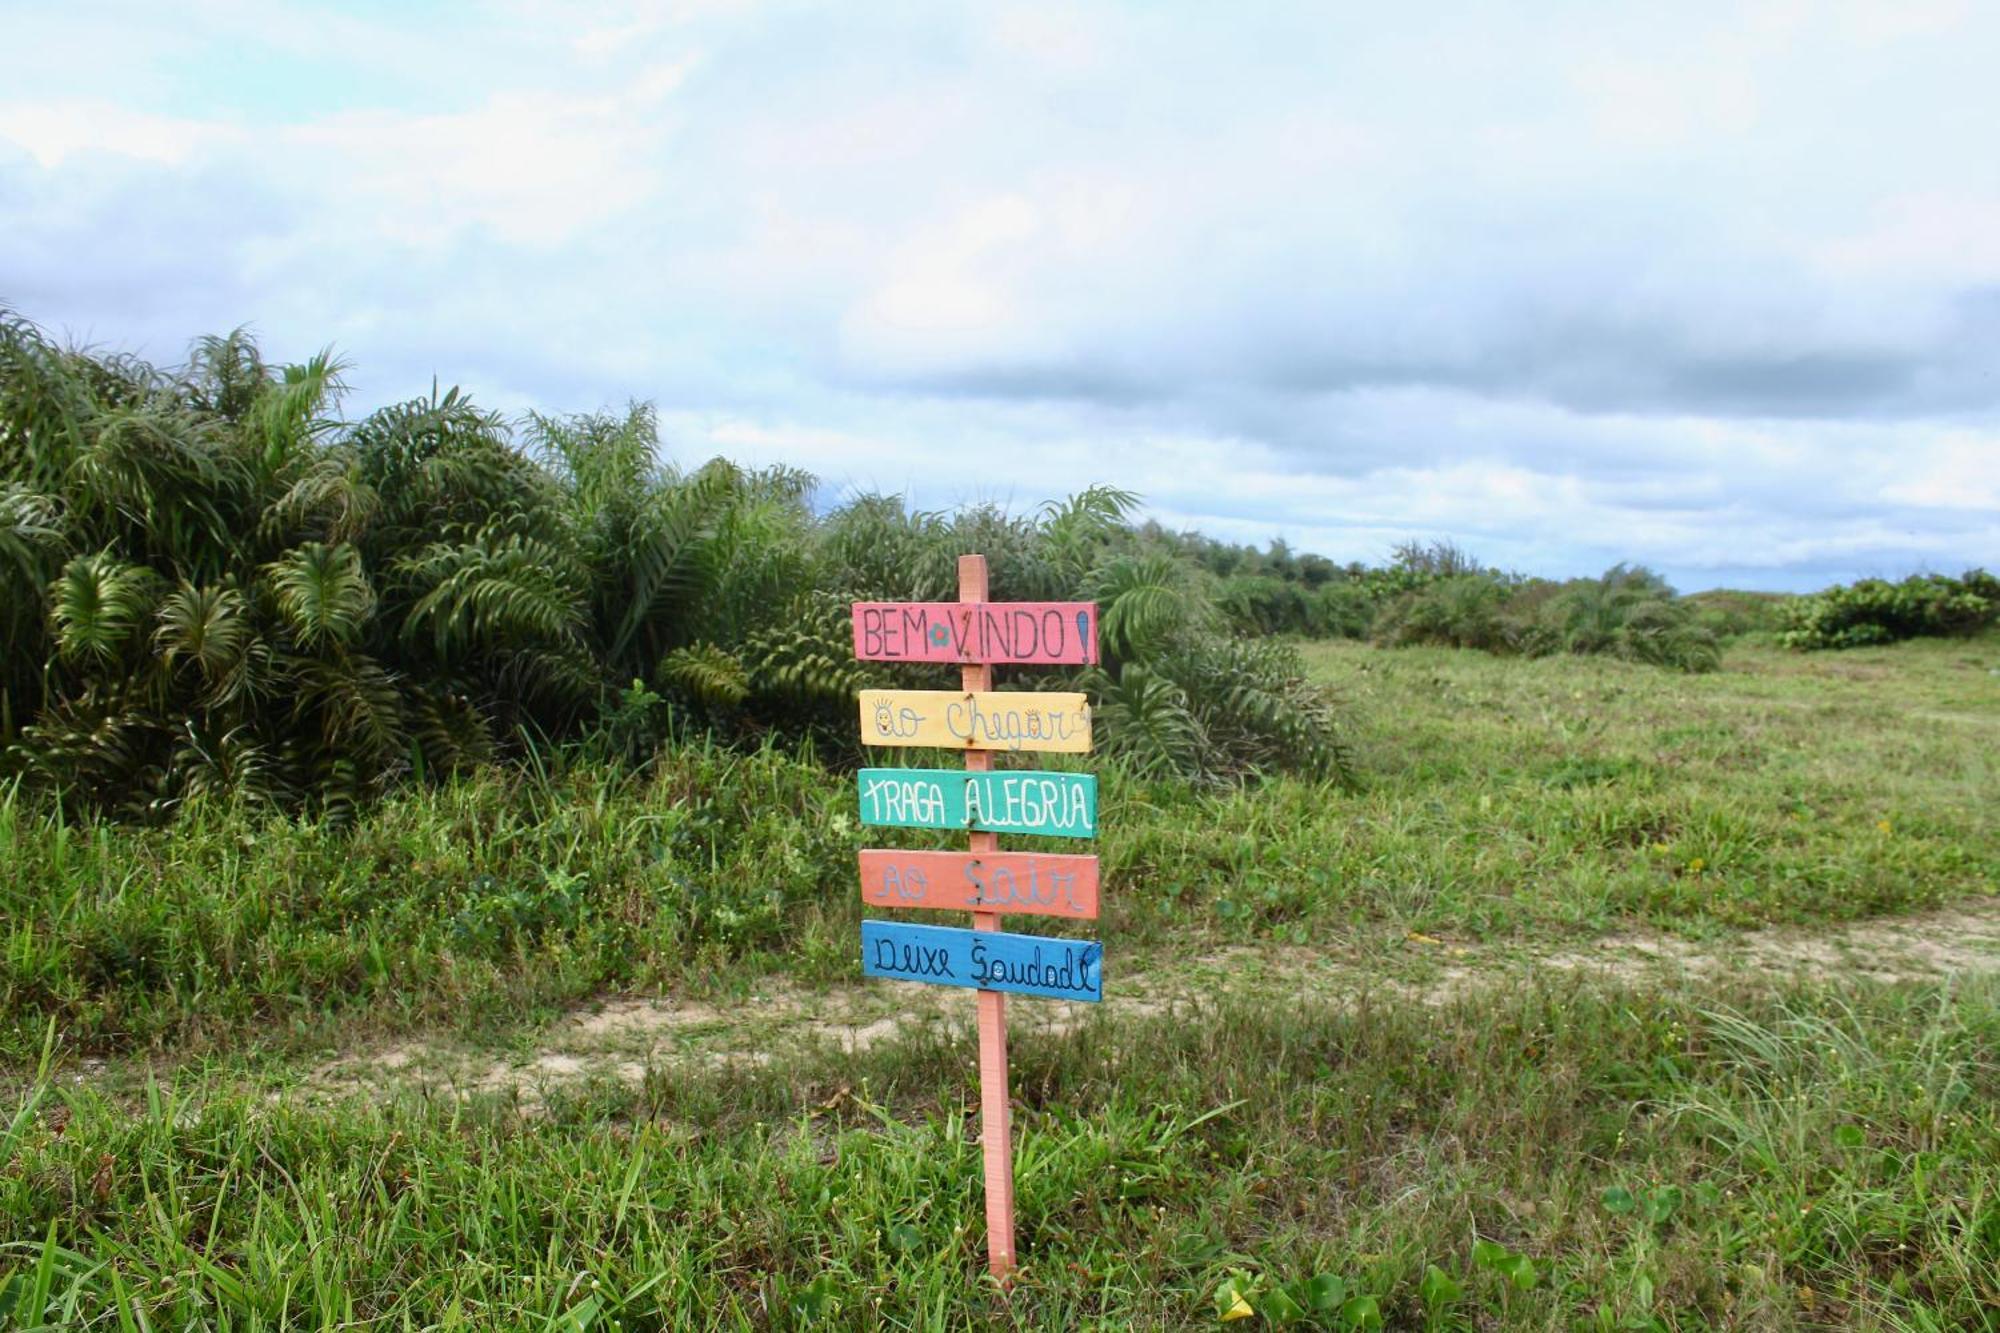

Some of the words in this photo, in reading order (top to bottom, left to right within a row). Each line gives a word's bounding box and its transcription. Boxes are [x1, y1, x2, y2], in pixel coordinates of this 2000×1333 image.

[863, 608, 929, 657] BEM
[863, 779, 946, 825] TRAGA
[960, 777, 1093, 830] ALEGRIA
[874, 864, 928, 900] AO
[874, 936, 956, 978] Deixe
